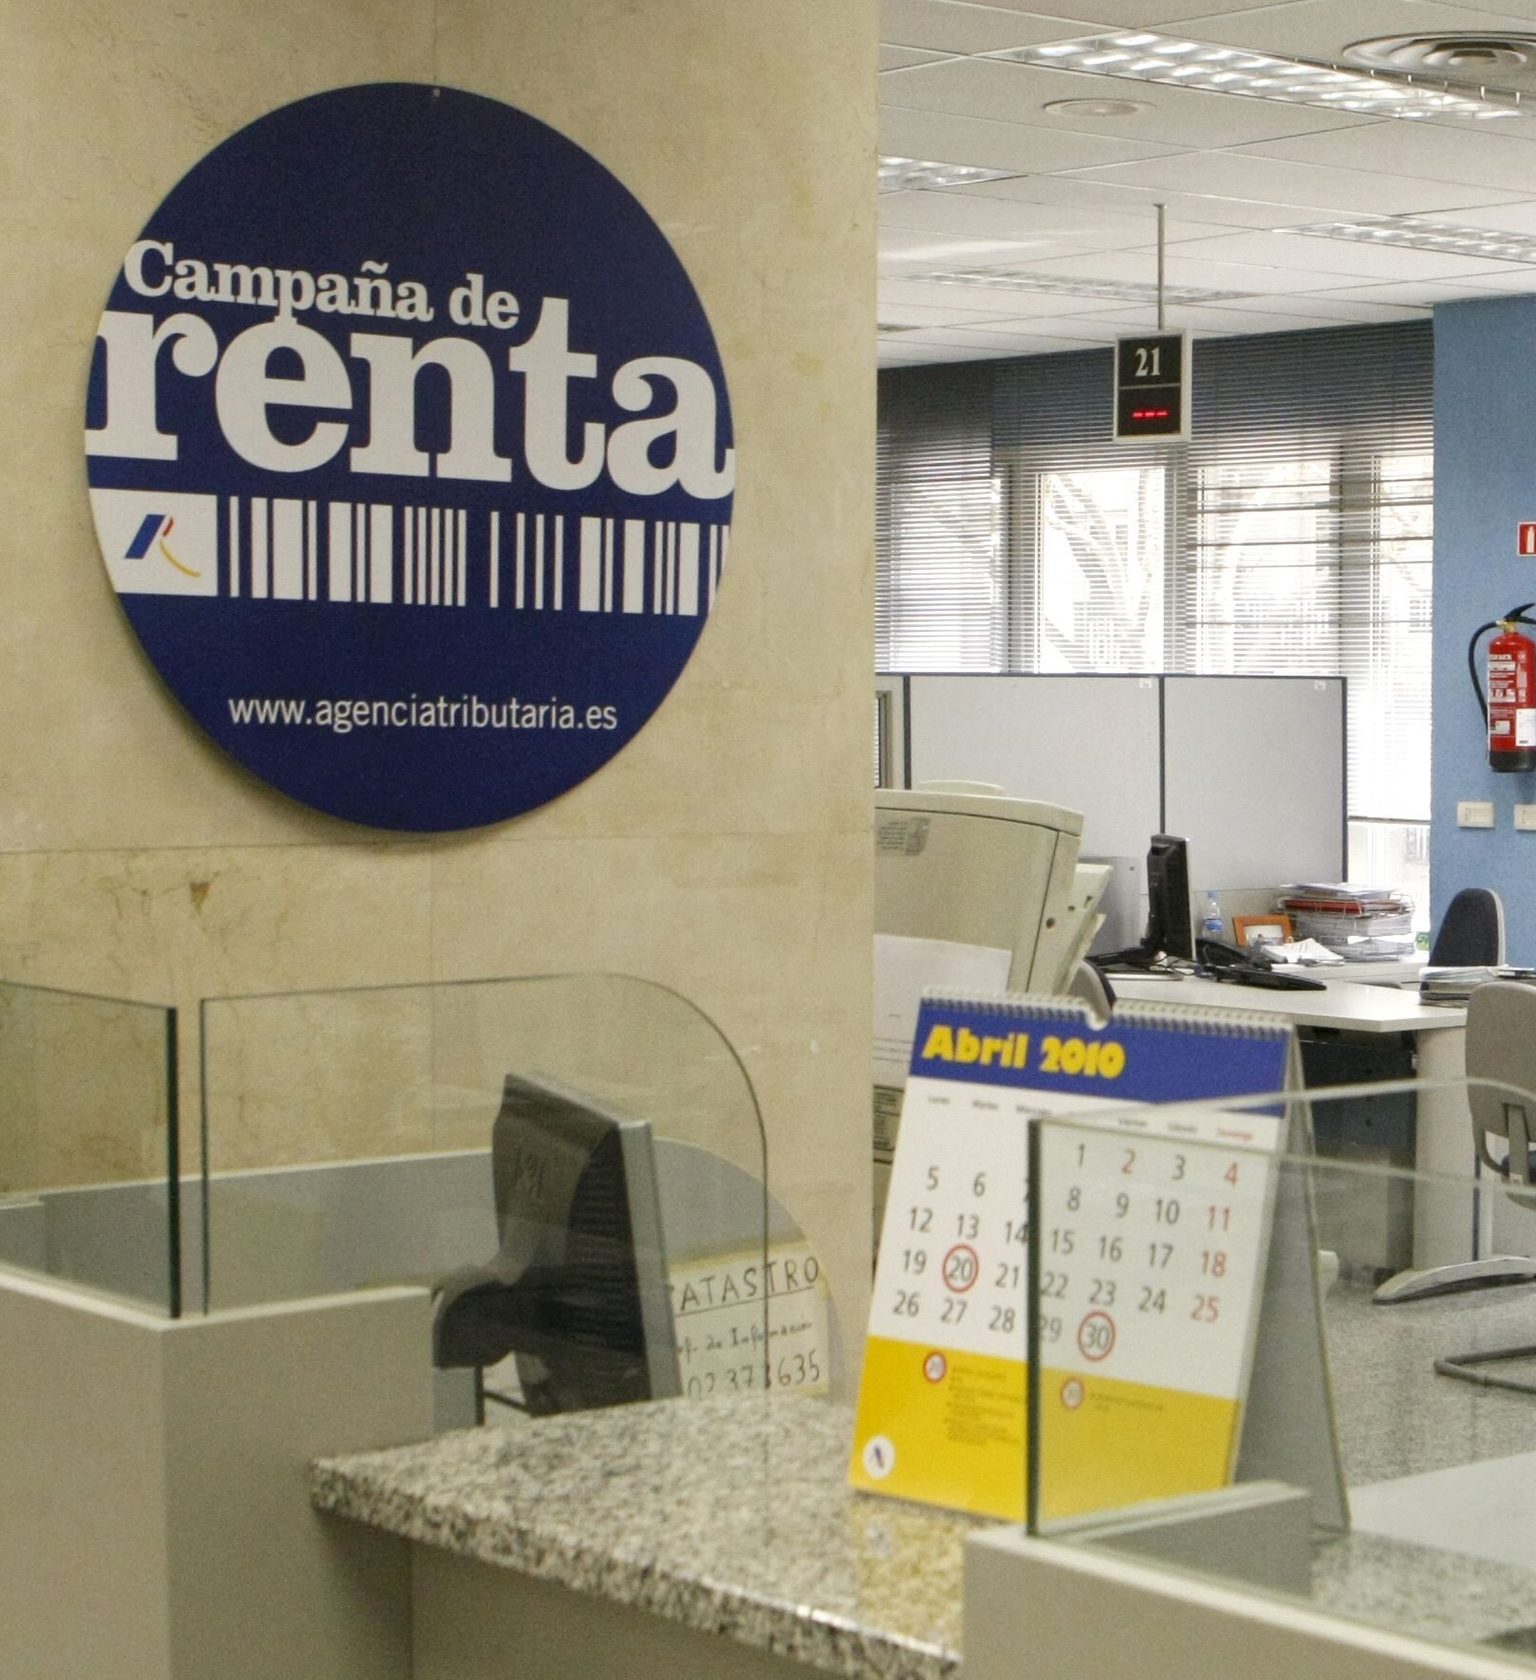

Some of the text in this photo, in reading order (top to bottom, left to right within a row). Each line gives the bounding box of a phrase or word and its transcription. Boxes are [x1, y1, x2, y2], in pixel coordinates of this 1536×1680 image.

[124, 239, 520, 329] Campaña de
[1135, 347, 1161, 377] 21
[85, 296, 736, 500] renta
[228, 693, 618, 733] www.agenciatributaria.es
[922, 1024, 1127, 1079] Abril 2010
[1077, 1143, 1239, 1187] 1 2 3 4
[926, 1165, 1231, 1232] 5 6 8 9 10 11
[910, 1206, 1227, 1278] 12 13 14 15 16 17 18
[665, 1256, 819, 1311] ATASTRO
[903, 1249, 1221, 1323] 19 20 21 22 23 24 25
[893, 1289, 920, 1318] 26
[940, 1299, 967, 1324] 27
[988, 1305, 1016, 1333] 28
[1083, 1321, 1112, 1351] 30
